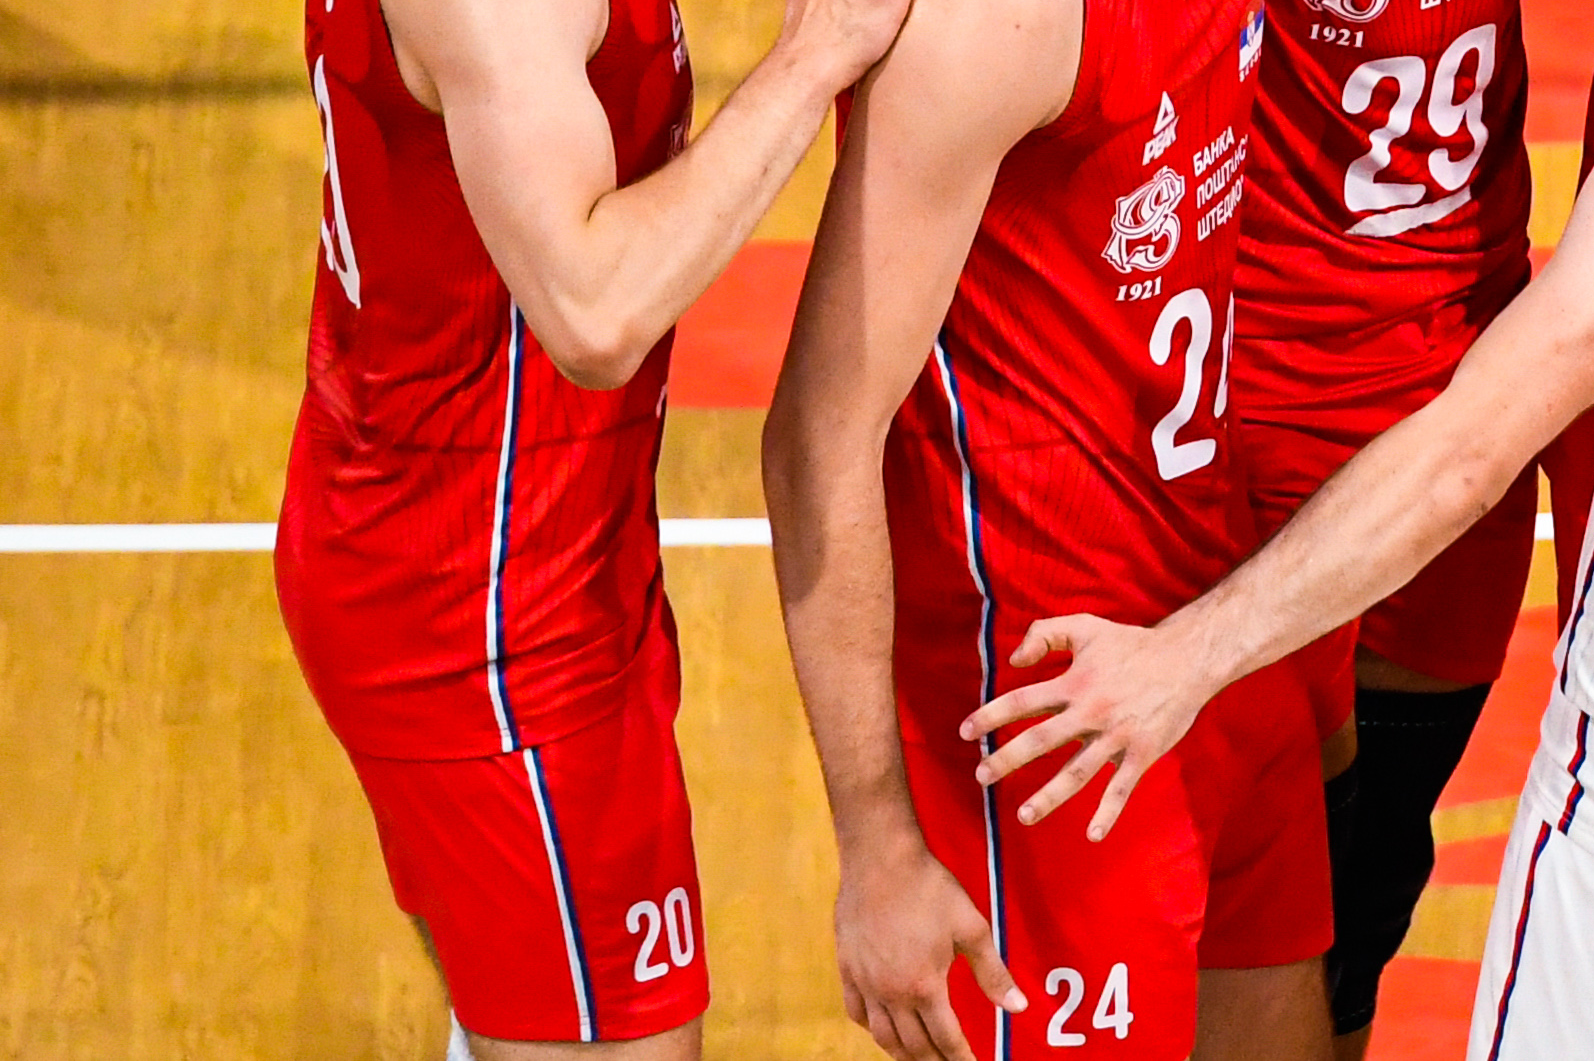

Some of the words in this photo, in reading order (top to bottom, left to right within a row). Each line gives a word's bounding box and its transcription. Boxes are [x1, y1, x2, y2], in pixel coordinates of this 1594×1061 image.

[1309, 23, 1364, 49] 1921
[1142, 115, 1180, 166] PEAK
[1341, 23, 1497, 213] 29
[1193, 125, 1235, 177] БАНКА
[1115, 275, 1162, 302] 1921
[625, 886, 695, 983] 20
[1045, 961, 1134, 1047] 24
